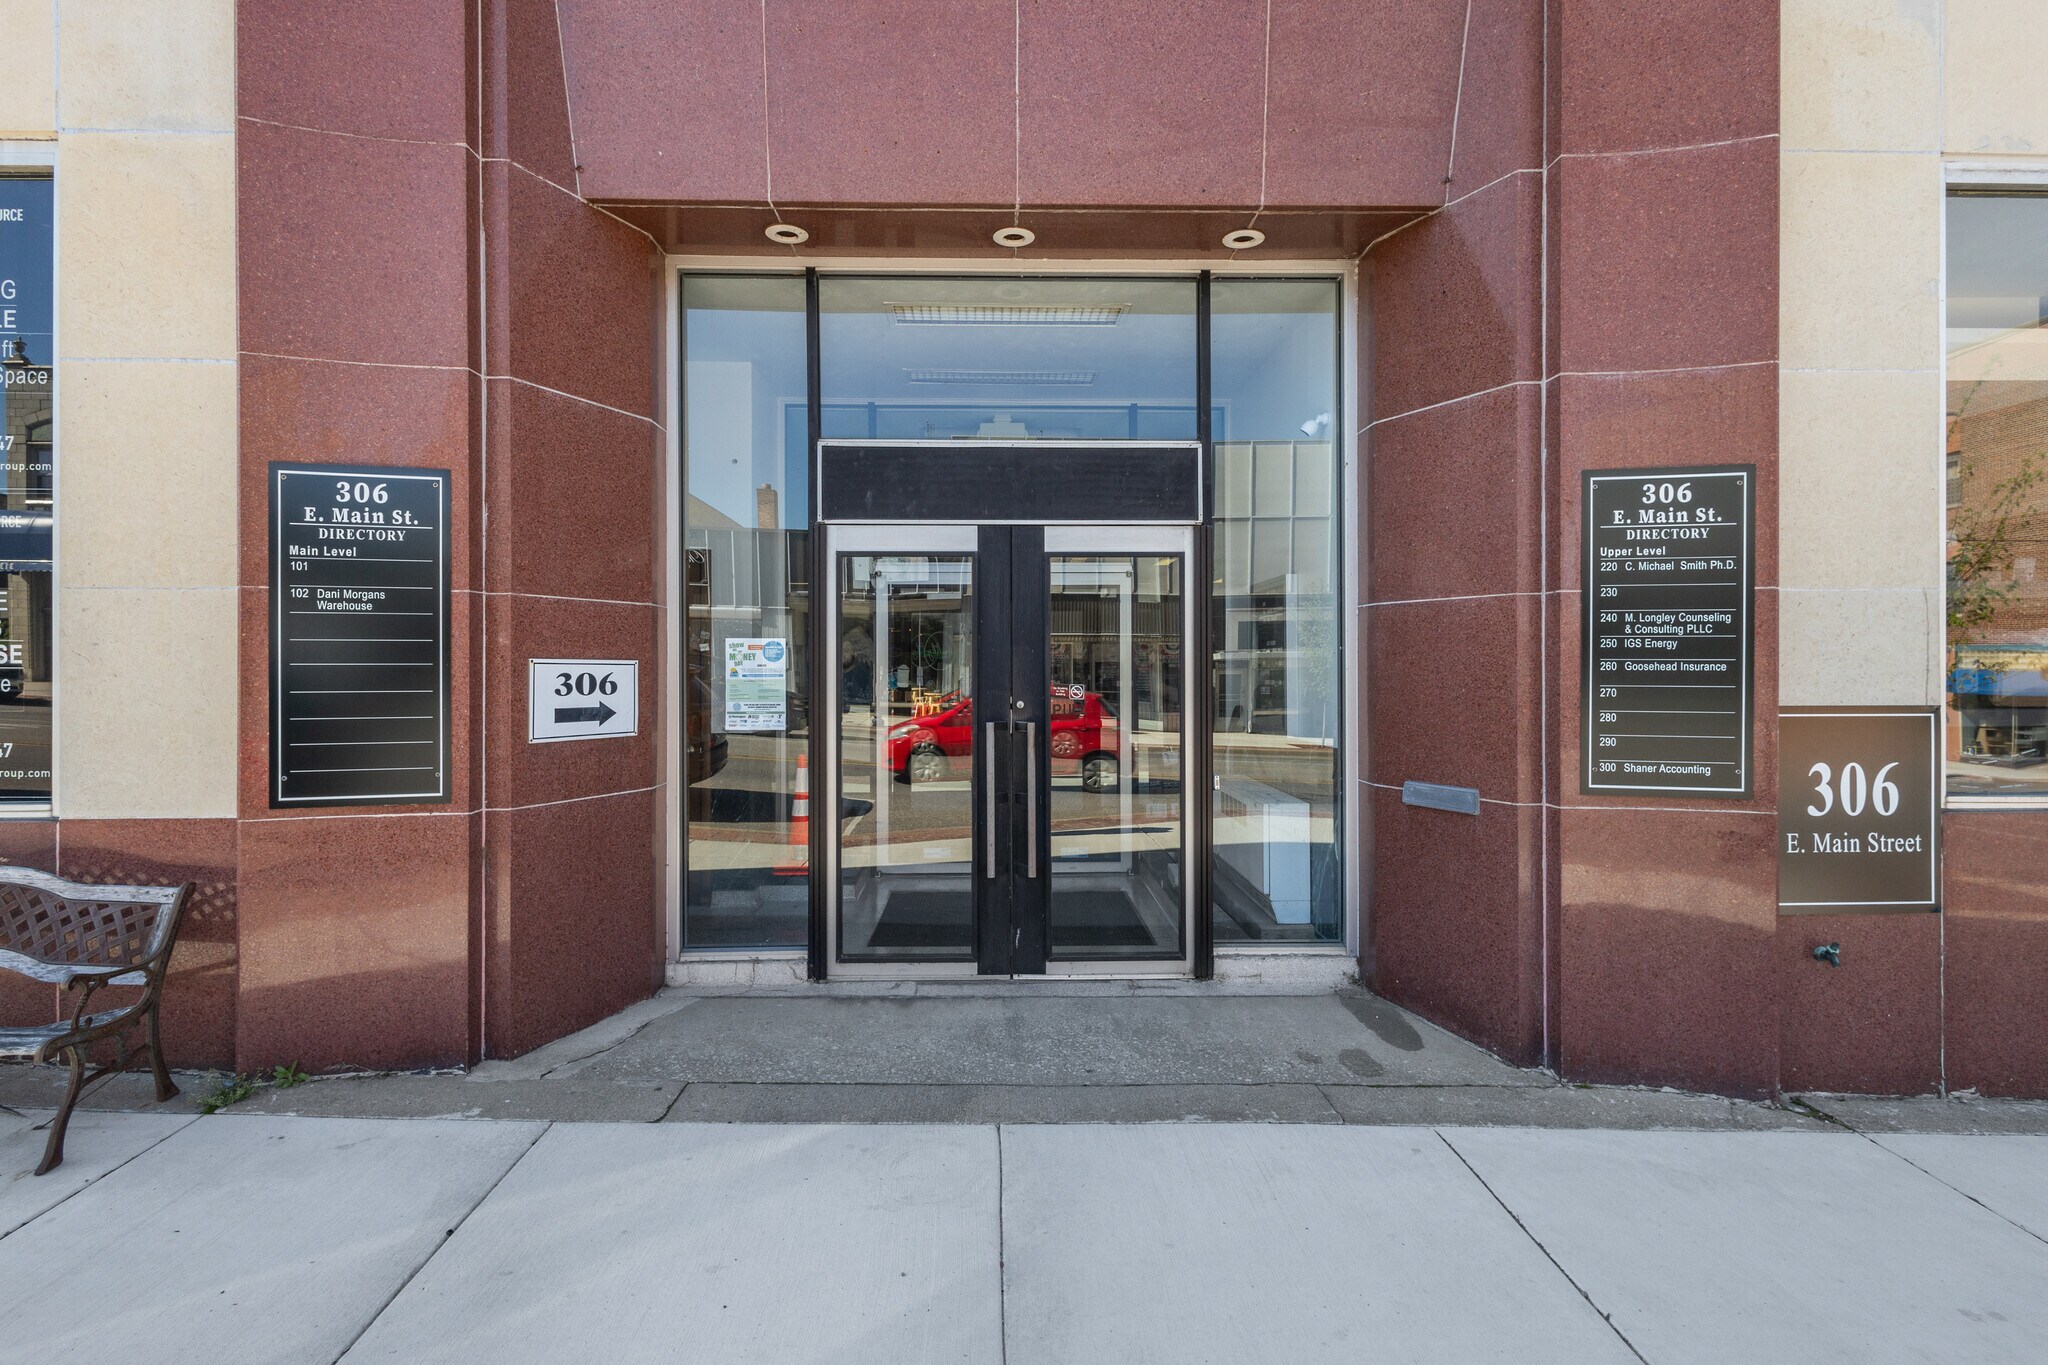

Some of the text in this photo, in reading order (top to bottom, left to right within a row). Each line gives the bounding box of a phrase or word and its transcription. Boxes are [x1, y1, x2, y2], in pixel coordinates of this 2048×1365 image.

[336, 482, 388, 503] 306
[1642, 482, 1692, 503] 306
[304, 507, 418, 525] E. Main St.
[1613, 507, 1722, 524] E. Main St.
[319, 528, 406, 541] DIRECTORY
[1626, 528, 1709, 540] DIRECTORY
[290, 545, 356, 556] Main Level
[1600, 546, 1665, 558] Upper Level
[290, 562, 308, 570] 101
[1601, 560, 1736, 571] 220 C. Michael Smith Ph.D.
[291, 589, 385, 601] 102 Dani Morgans
[1601, 588, 1617, 597] 230
[317, 601, 372, 610] Warehouse
[1601, 613, 1731, 623] 240 M. Longley Counseling
[1625, 625, 1712, 635] & Consulting PLLC
[1601, 639, 1678, 649] 250 IGS Energy
[1600, 662, 1727, 671] 260 Goosehead Insurance
[554, 672, 618, 696] 306
[1600, 688, 1617, 697] 270
[1600, 713, 1617, 722] 280
[1600, 738, 1616, 746] 290
[1600, 763, 1711, 776] 300 Shaner Accounting
[1807, 762, 1899, 816] 306
[1787, 832, 1921, 853] E. Main Street
